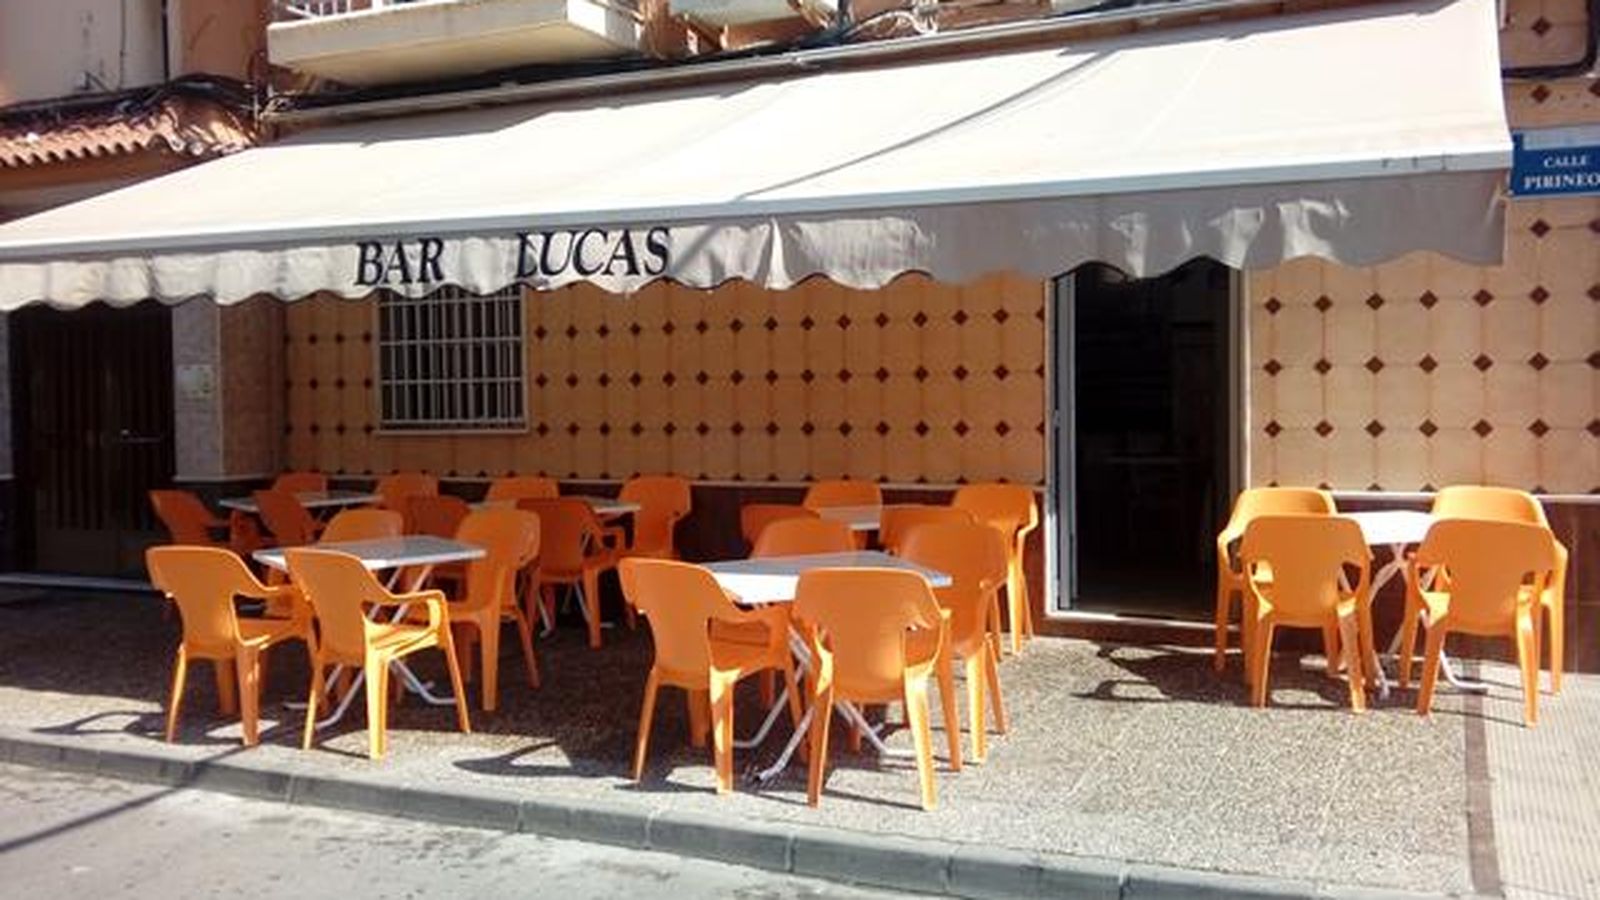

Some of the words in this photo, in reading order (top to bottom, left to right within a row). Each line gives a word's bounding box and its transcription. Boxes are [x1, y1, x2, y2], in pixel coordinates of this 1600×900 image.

[1543, 155, 1588, 168] CALLE
[355, 237, 445, 285] BAR
[515, 227, 670, 279] LUCAS
